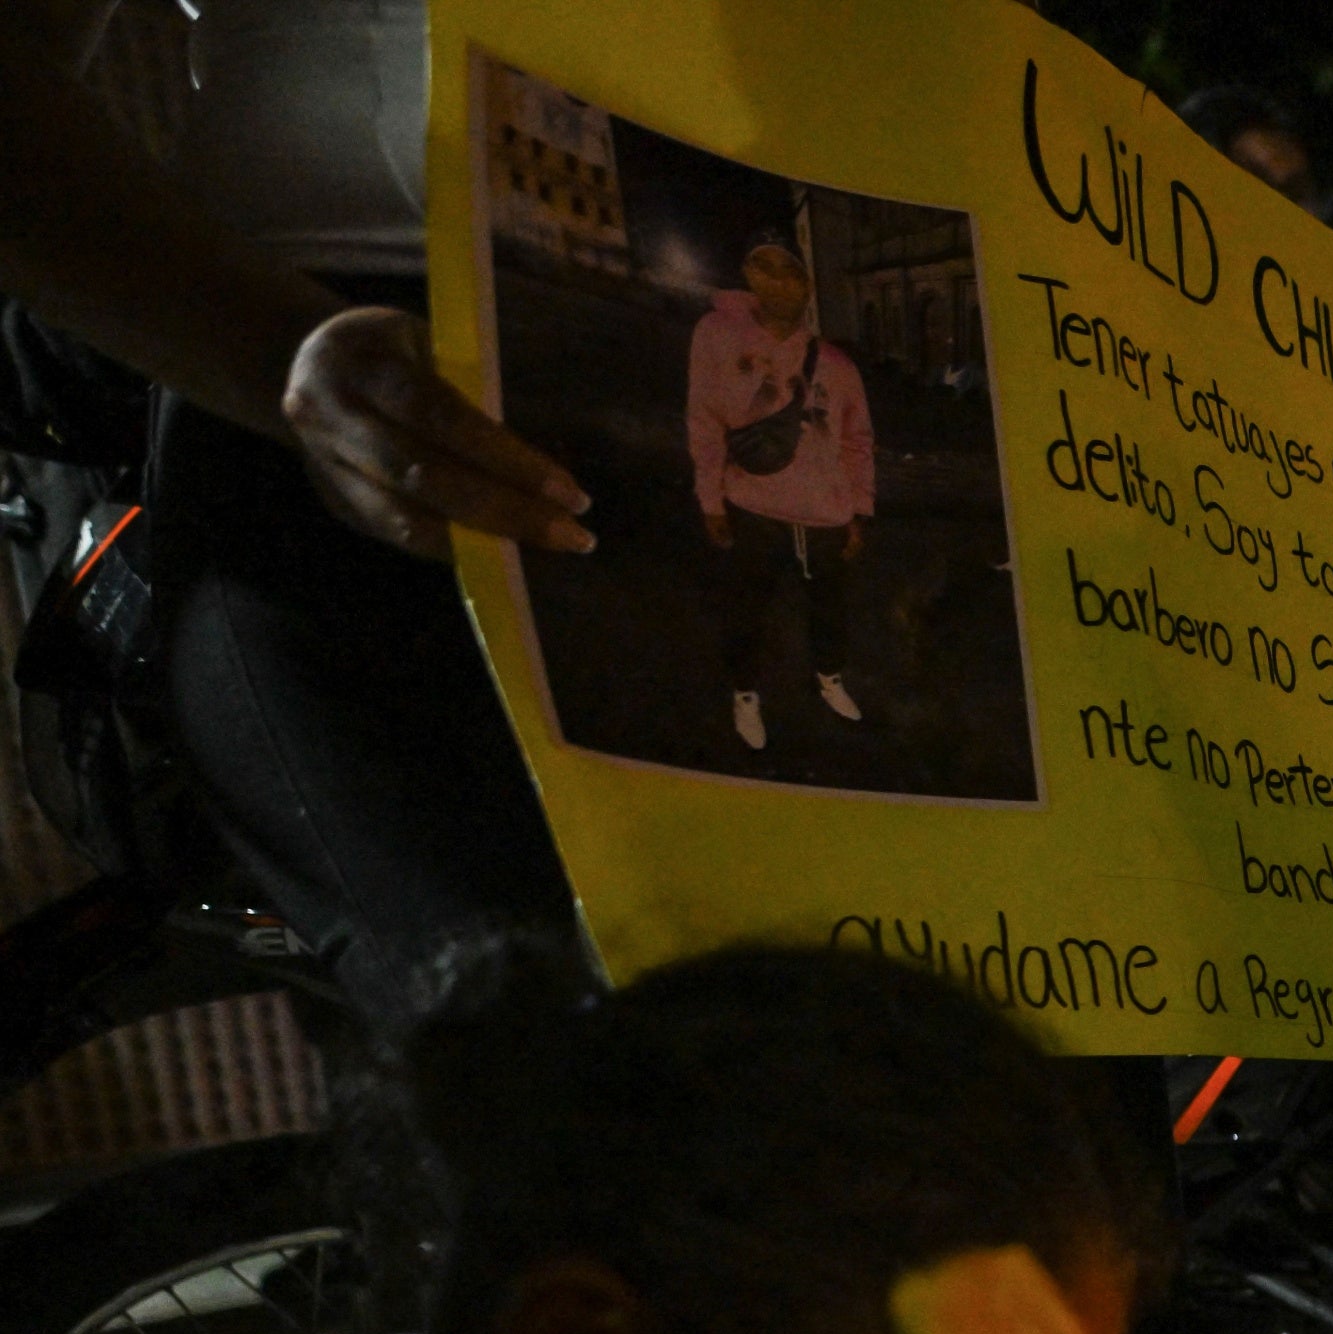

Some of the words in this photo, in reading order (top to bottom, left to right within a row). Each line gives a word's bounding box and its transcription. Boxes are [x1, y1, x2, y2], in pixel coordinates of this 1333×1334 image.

[1018, 274, 1150, 400] Tener
[1163, 354, 1324, 498] tatuajes
[1194, 464, 1278, 592] Soy
[1066, 548, 1233, 665] barbero
[1250, 626, 1296, 693] no
[1079, 699, 1172, 770] nte
[1187, 728, 1230, 789] no
[1196, 959, 1227, 1013] a
